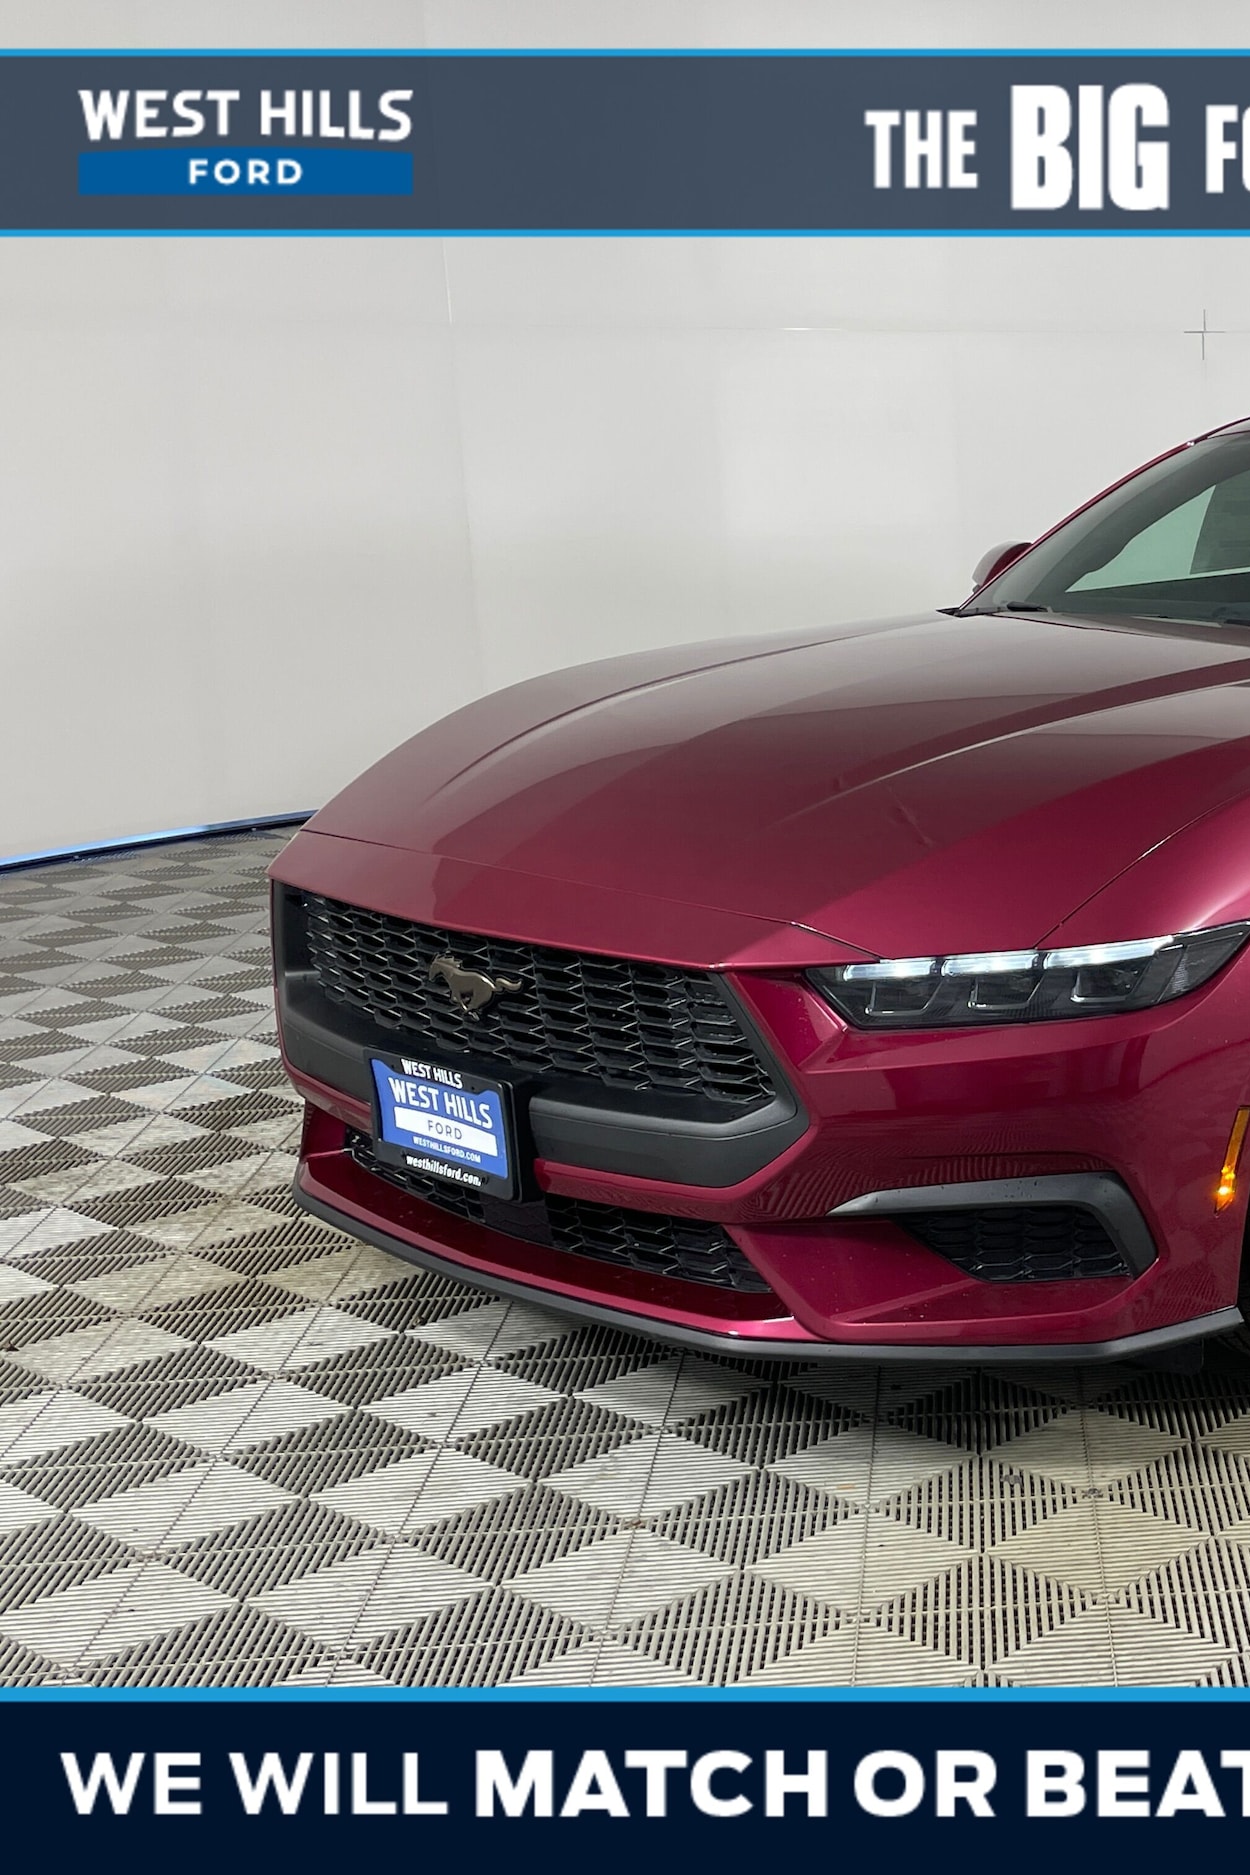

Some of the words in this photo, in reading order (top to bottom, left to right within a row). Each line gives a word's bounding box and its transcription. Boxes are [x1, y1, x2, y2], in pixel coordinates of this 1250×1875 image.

[401, 1058, 431, 1079] WEST
[433, 1067, 463, 1089] HILLS
[388, 1077, 439, 1111] WEST
[443, 1092, 493, 1129] HILLS
[427, 1119, 463, 1140] FORD
[412, 1135, 481, 1164] WESTHILLSFORD.COM
